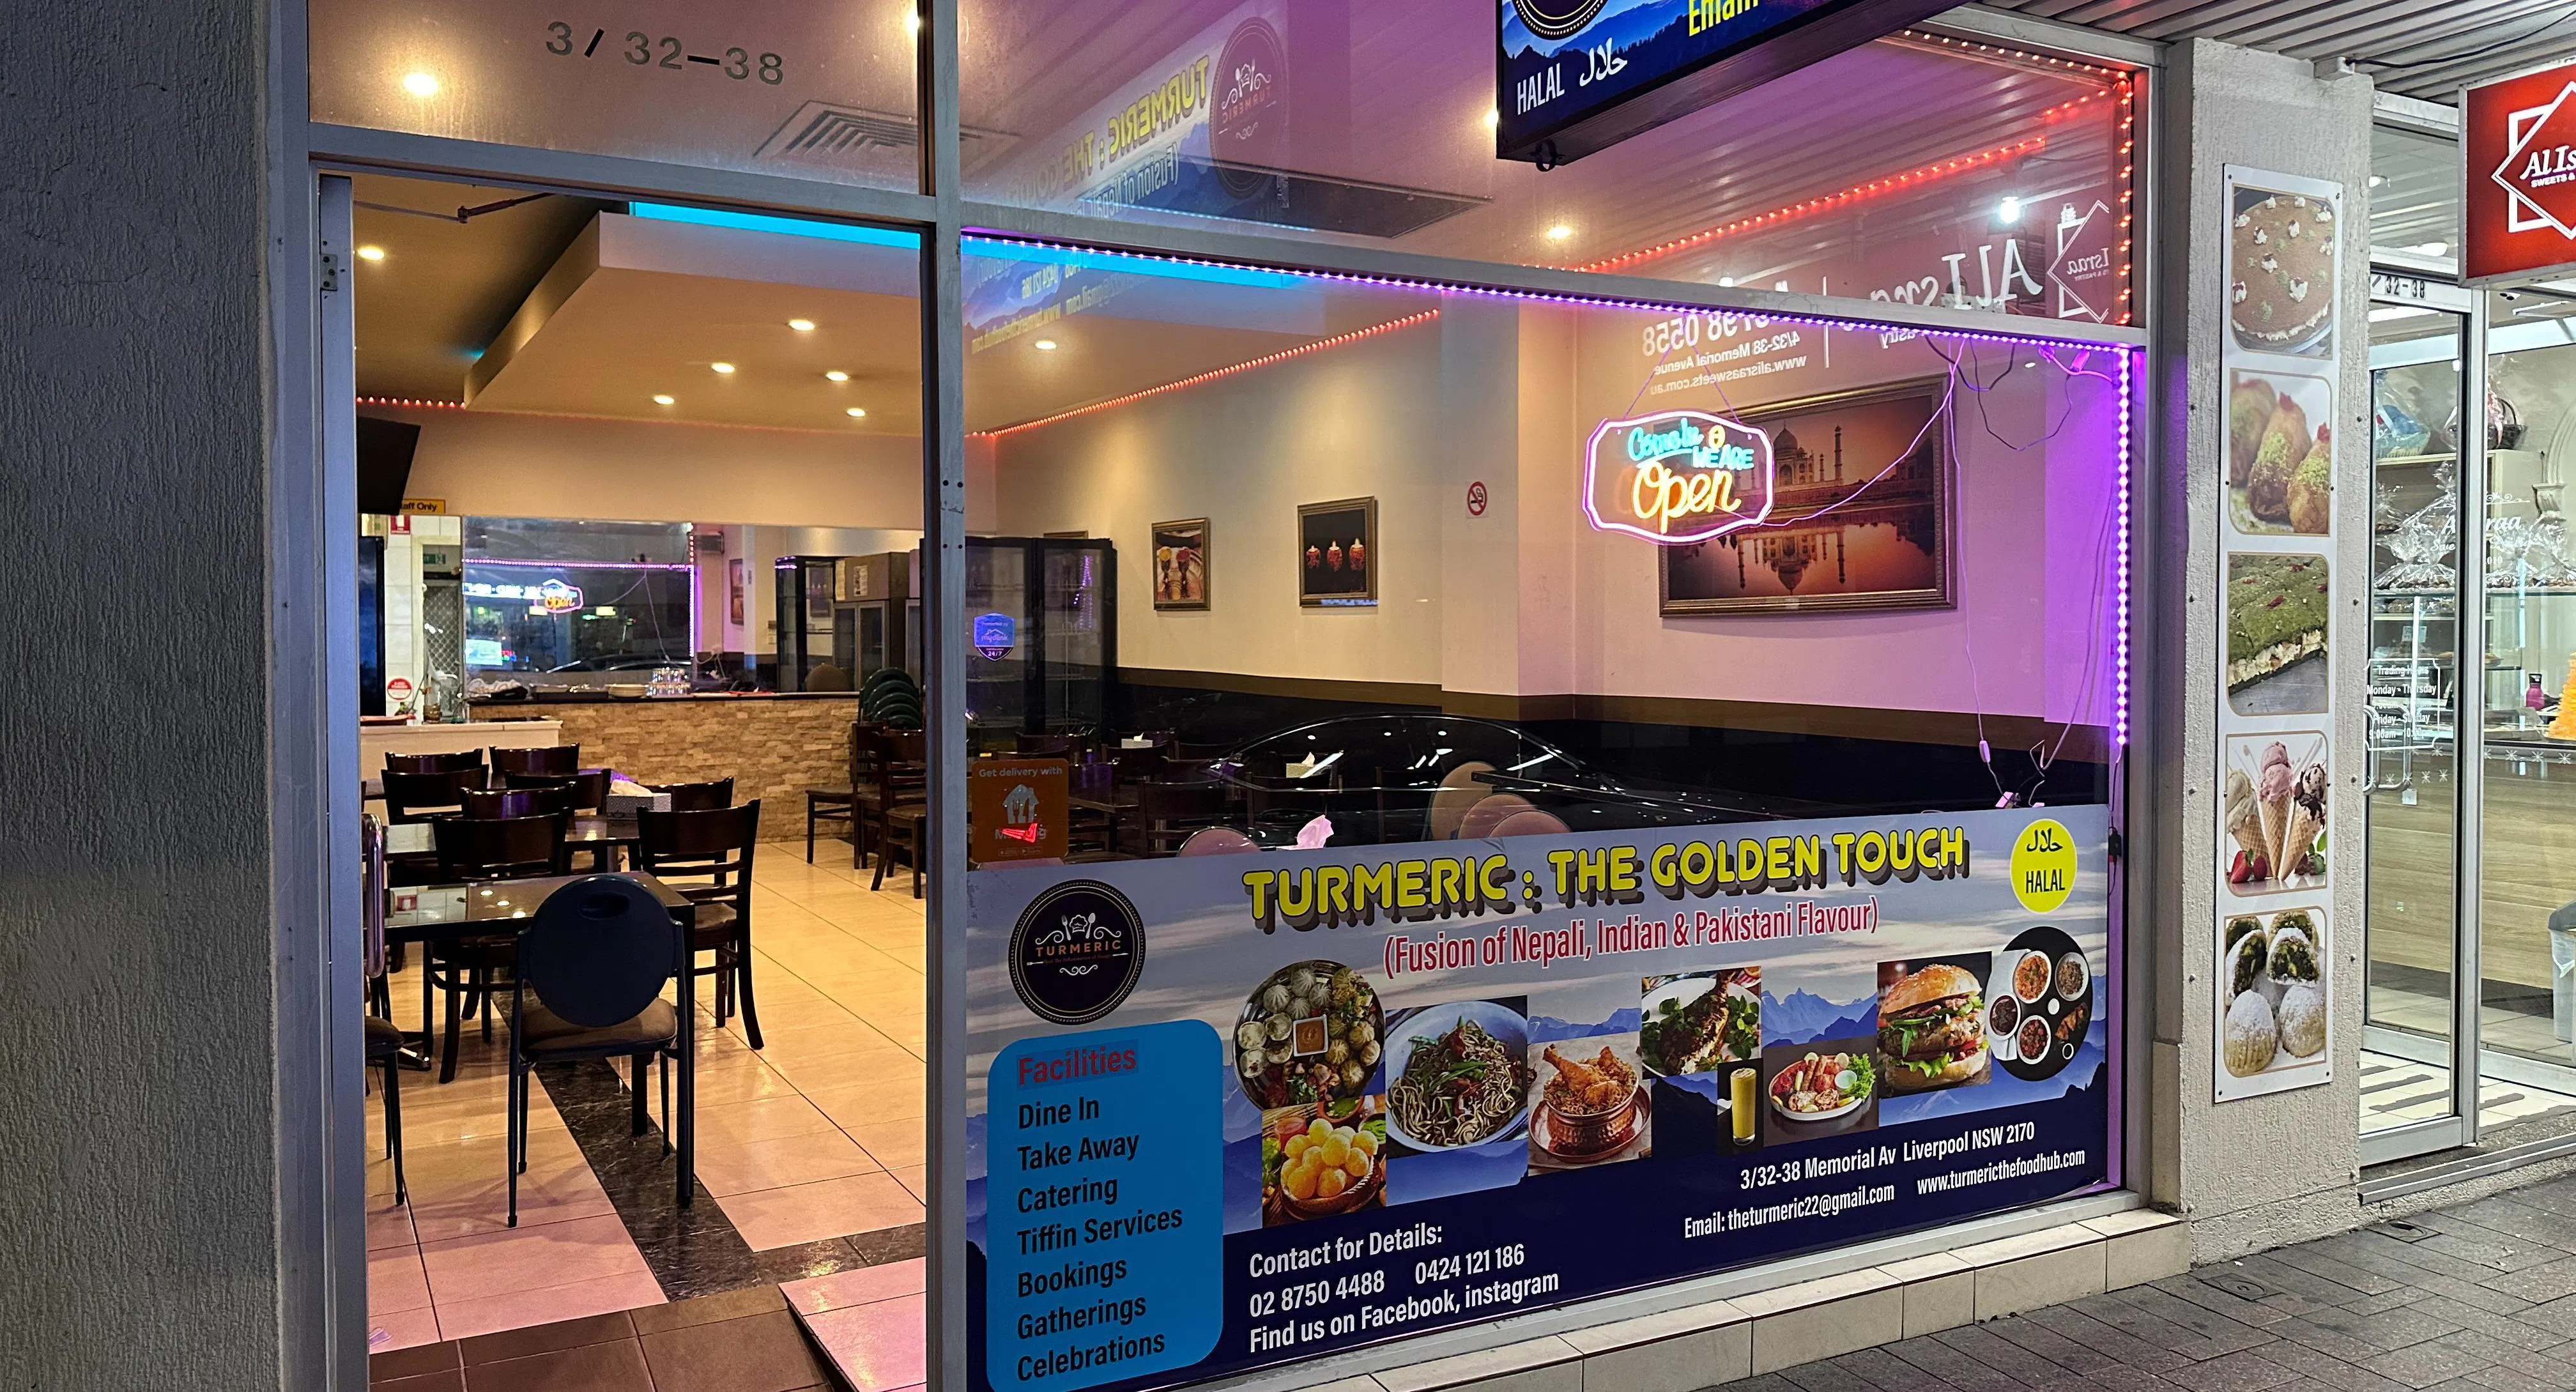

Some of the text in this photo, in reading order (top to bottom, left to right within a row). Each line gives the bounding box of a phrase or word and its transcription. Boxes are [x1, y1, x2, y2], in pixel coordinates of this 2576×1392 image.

[1579, 37, 1628, 87] حلال
[1517, 63, 1565, 115] HALAL
[2531, 173, 2567, 188] SWEETS
[1692, 443, 1754, 471] WE ARE
[417, 501, 438, 512] Only
[1632, 461, 1742, 534] Open
[2366, 684, 2396, 696] Monday
[2402, 684, 2437, 696] Thrsday
[979, 766, 1062, 777] Get delivery with
[2027, 828, 2063, 853] حلال
[1242, 853, 1512, 928] TURMERIC
[1547, 844, 1640, 902] THE
[1650, 835, 1825, 893] GOLDEN
[1832, 826, 1966, 880] TOUCH
[2026, 868, 2066, 894] HALAL
[1036, 940, 1121, 958] TURMERIC
[1384, 895, 1880, 979] (Fusion of Nepali, Indian & Pakistani Flavour)
[1018, 1044, 1136, 1085] Facilities
[1018, 1096, 1100, 1129] Dine In
[1017, 1134, 1140, 1171] Take Away
[1740, 1121, 2035, 1190] 3/32-38 Memorial Av Liverpool NSW 2170
[1917, 1147, 2085, 1197] www.turmericthefoodhub.com
[1018, 1177, 1118, 1213] Catering
[1684, 1183, 1895, 1239] Email: theturmeric22@gmail.com
[1017, 1208, 1183, 1256] Tiffin Services
[1250, 1222, 1443, 1278] Contact for Details:
[1018, 1258, 1127, 1299] Bookings
[1415, 1243, 1524, 1285] 0424 121 186
[1250, 1269, 1385, 1318] 02 8750 4488
[1250, 1273, 1560, 1353] Find us on Facebook, instagram
[1018, 1296, 1147, 1340] Gatherings
[1018, 1333, 1165, 1381] Celebrations
